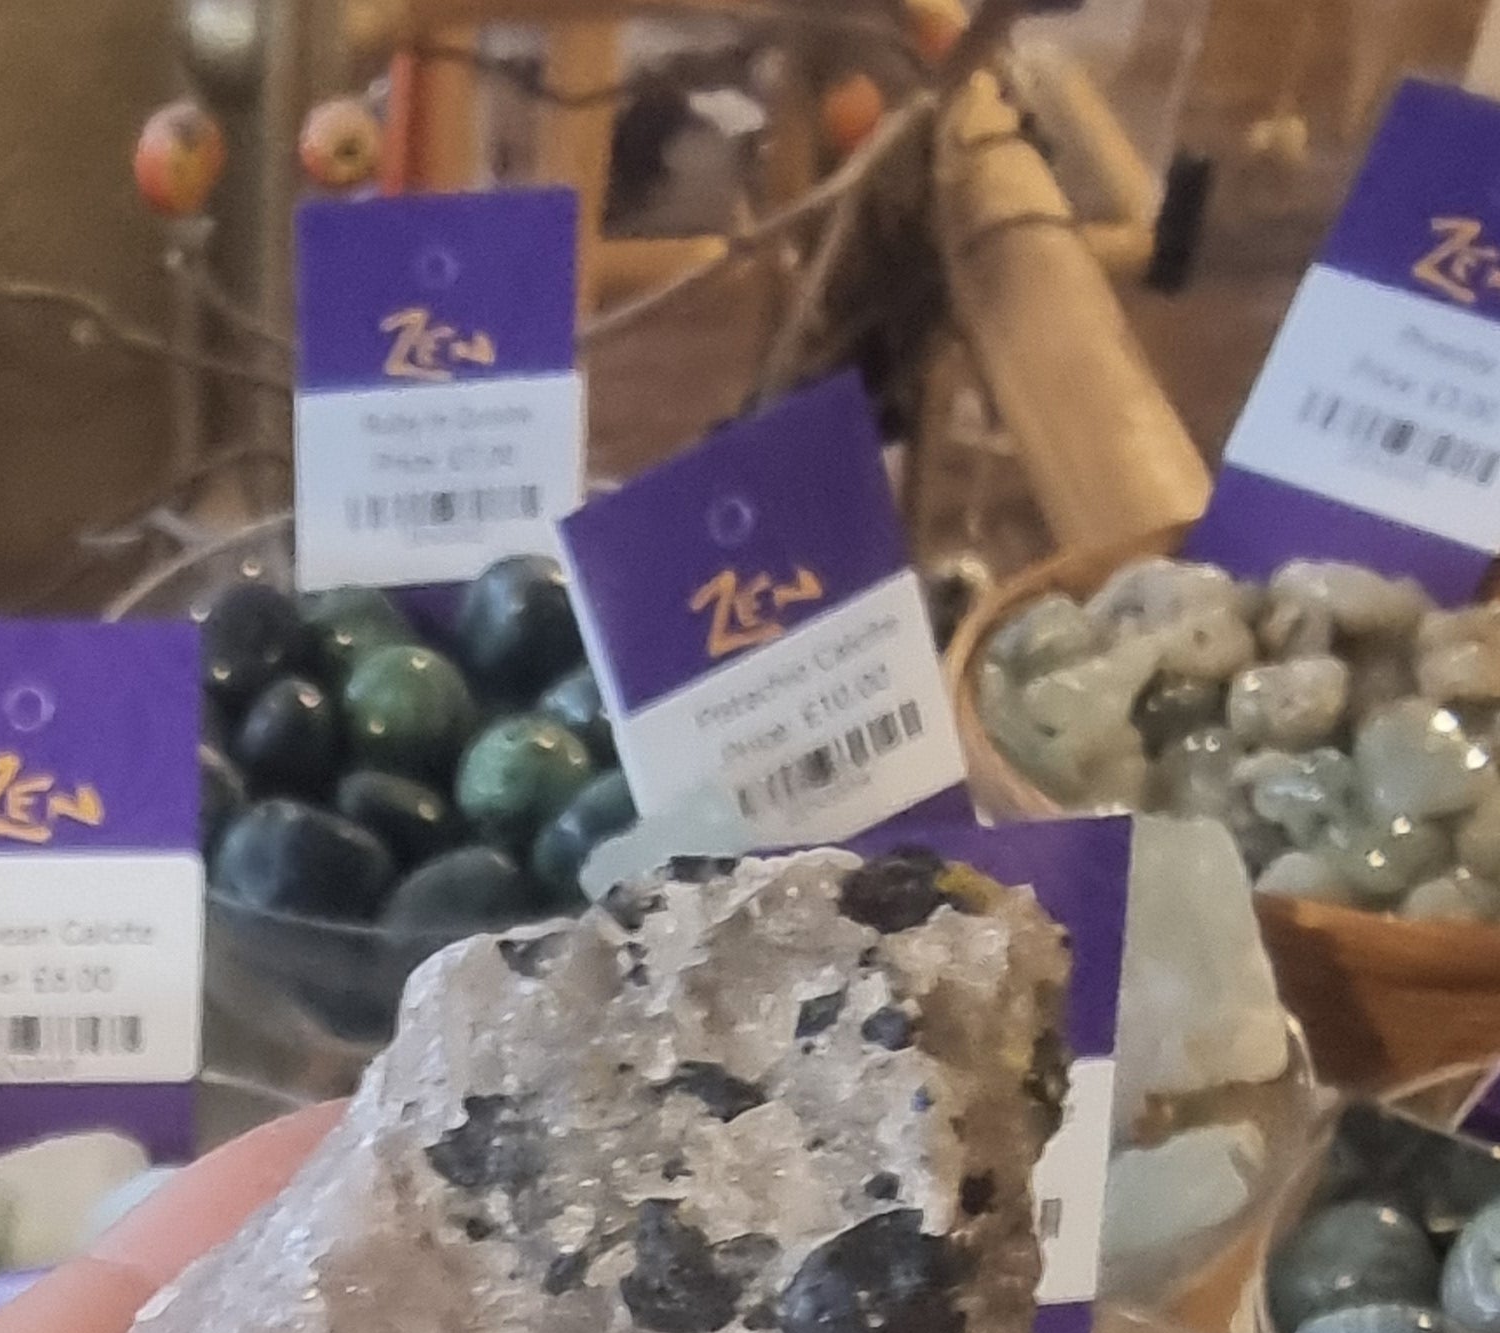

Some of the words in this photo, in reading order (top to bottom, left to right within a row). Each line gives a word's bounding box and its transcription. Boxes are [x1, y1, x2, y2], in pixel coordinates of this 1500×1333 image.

[1412, 217, 1500, 305] ZE
[379, 308, 496, 380] ZEN
[690, 568, 824, 658] ZEN
